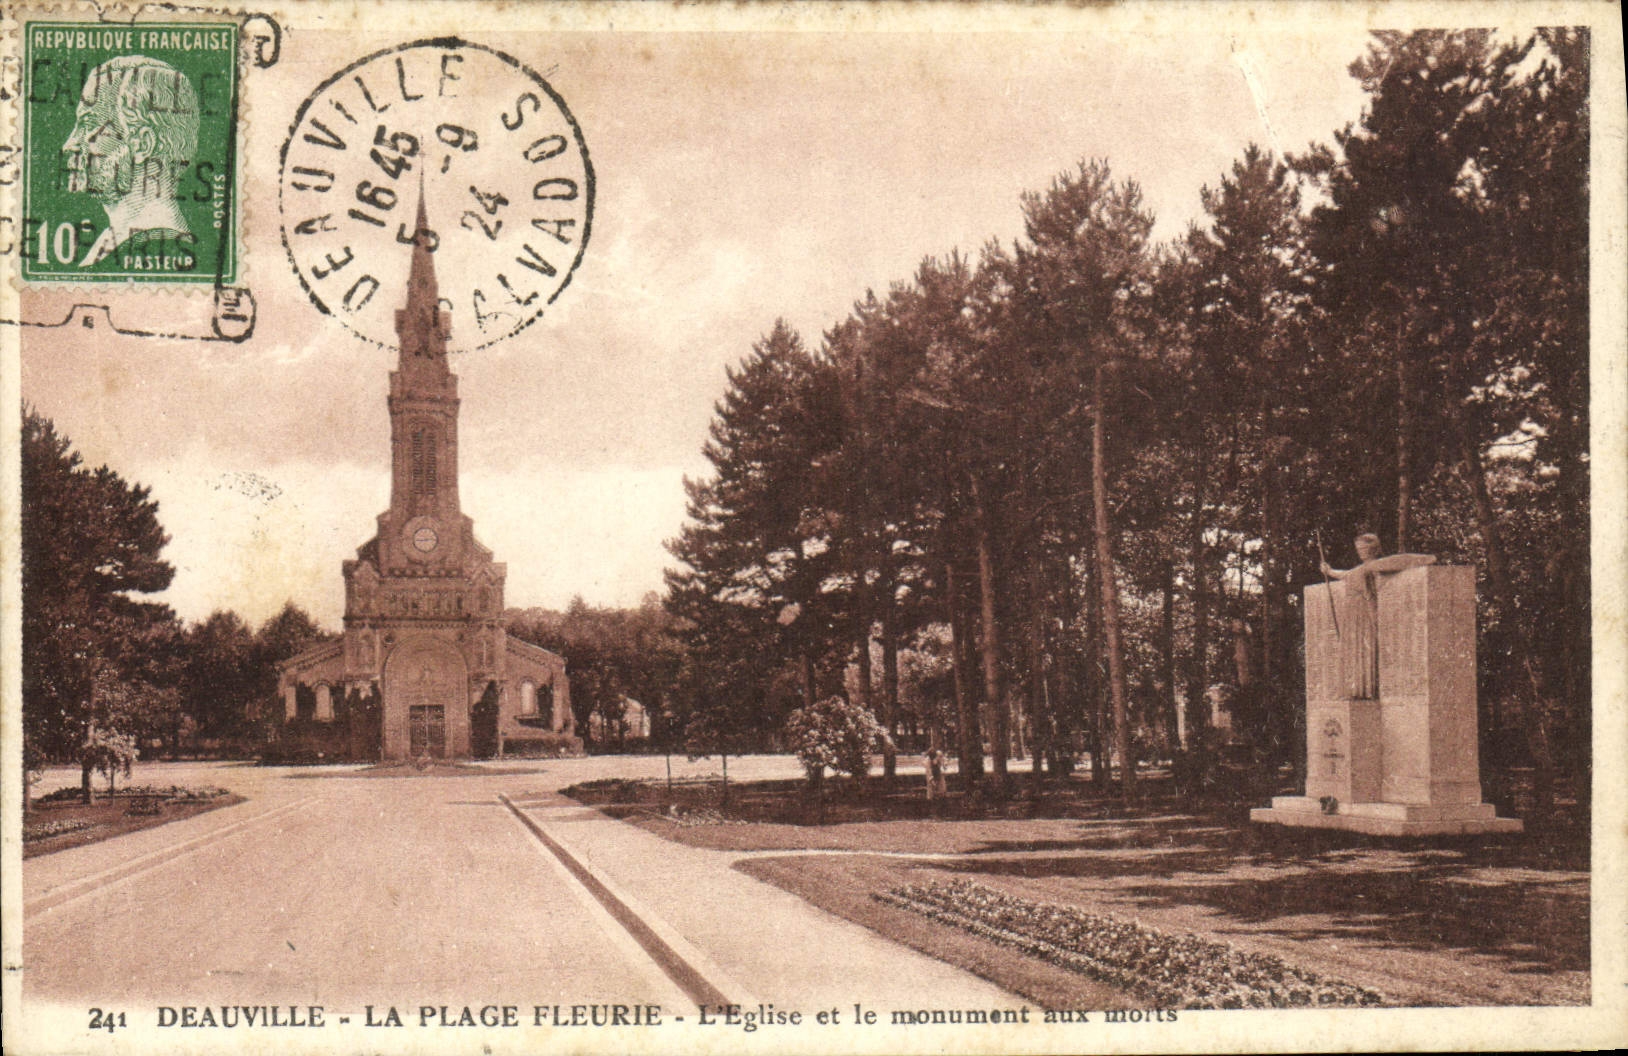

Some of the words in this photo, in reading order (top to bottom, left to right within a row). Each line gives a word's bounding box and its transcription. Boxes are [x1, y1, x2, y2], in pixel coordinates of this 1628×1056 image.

[140, 31, 229, 51] FRANÇAISE
[56, 148, 214, 203] HEURES
[212, 174, 226, 229] POSTES
[291, 54, 464, 313] DEAUVILLE
[460, 185, 509, 240] 24
[74, 220, 198, 272] PARIS
[123, 255, 194, 270] PASTEUR
